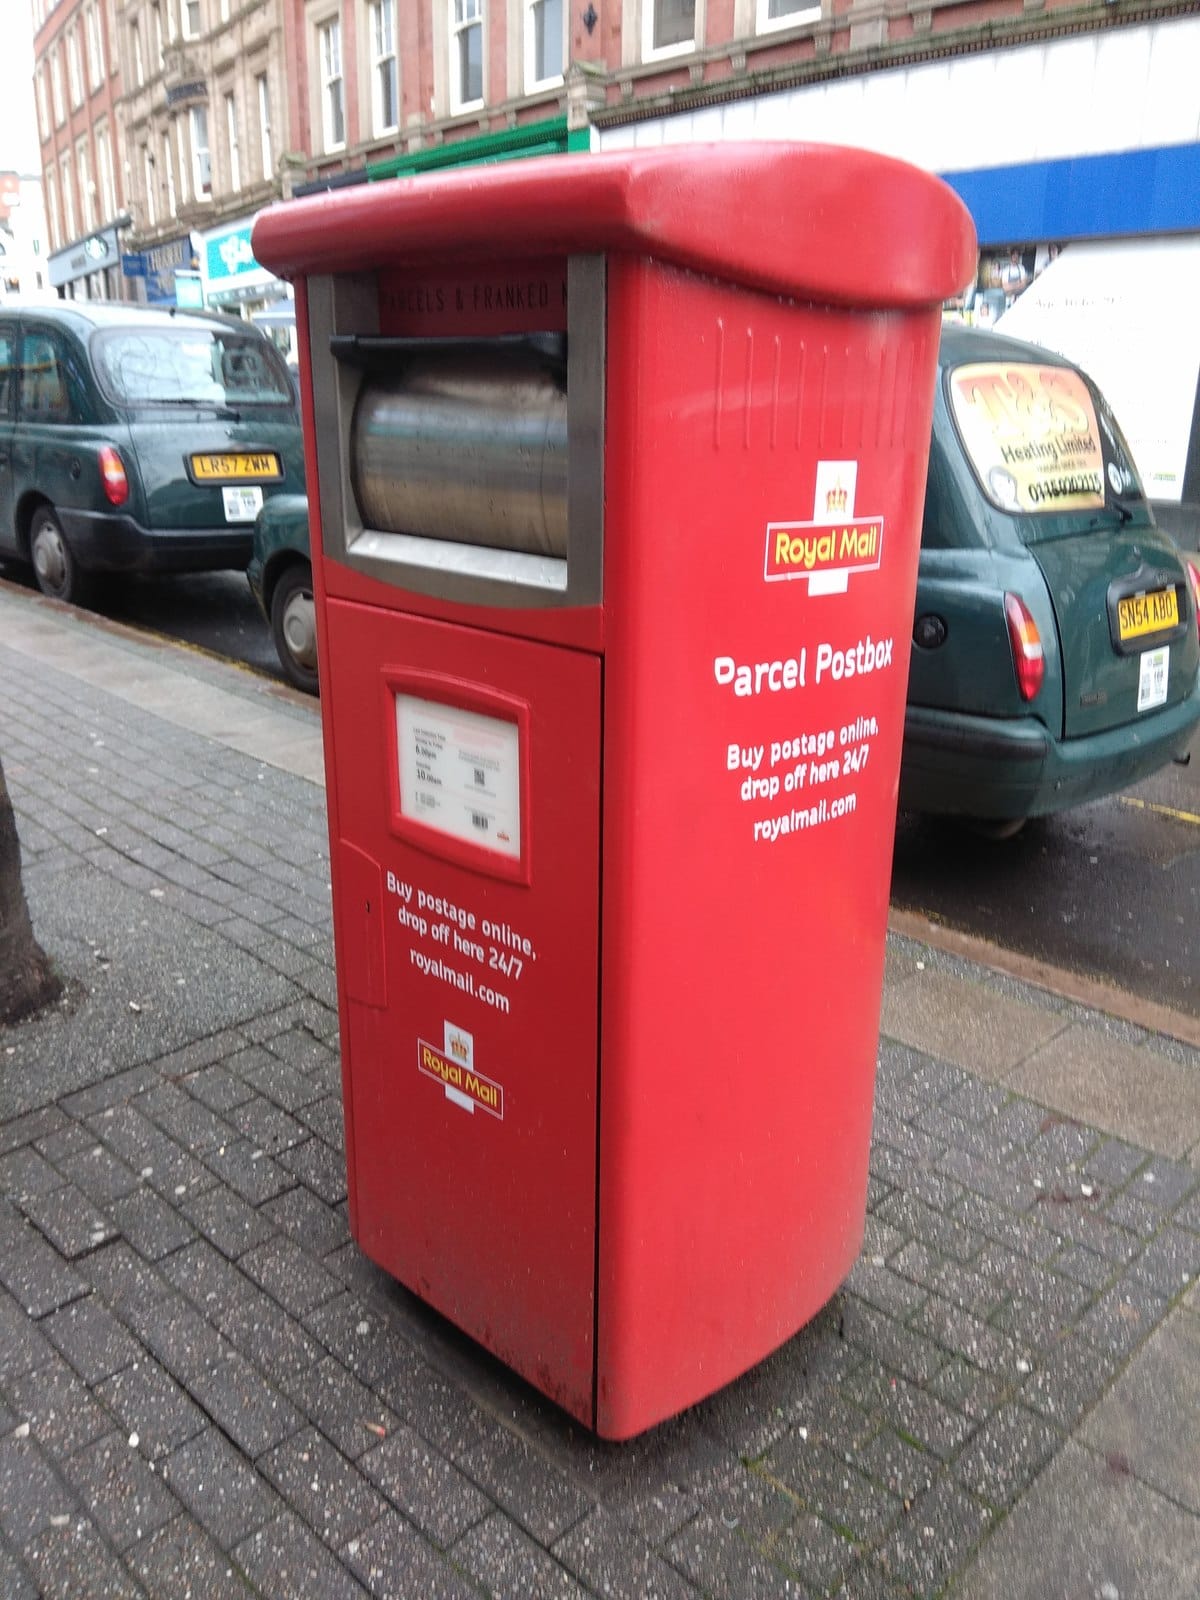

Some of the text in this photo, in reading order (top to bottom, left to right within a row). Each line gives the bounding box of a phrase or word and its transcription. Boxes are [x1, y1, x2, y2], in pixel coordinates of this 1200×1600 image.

[455, 287, 464, 310] &
[473, 283, 548, 311] FRANKED
[1000, 433, 1096, 465] Heating Limited
[775, 526, 878, 569] Royal Mail
[1119, 599, 1149, 630] SN54
[815, 635, 893, 685] Postbox
[727, 715, 879, 771] Buy postage online,
[740, 743, 869, 802] drop off here 24/7
[753, 792, 857, 842] royalmail.com
[387, 870, 538, 960] Buy postage online,
[398, 904, 523, 980] drop off here 24/7
[410, 948, 510, 1014] royalmail.com
[423, 1047, 498, 1107] Royal Mail
